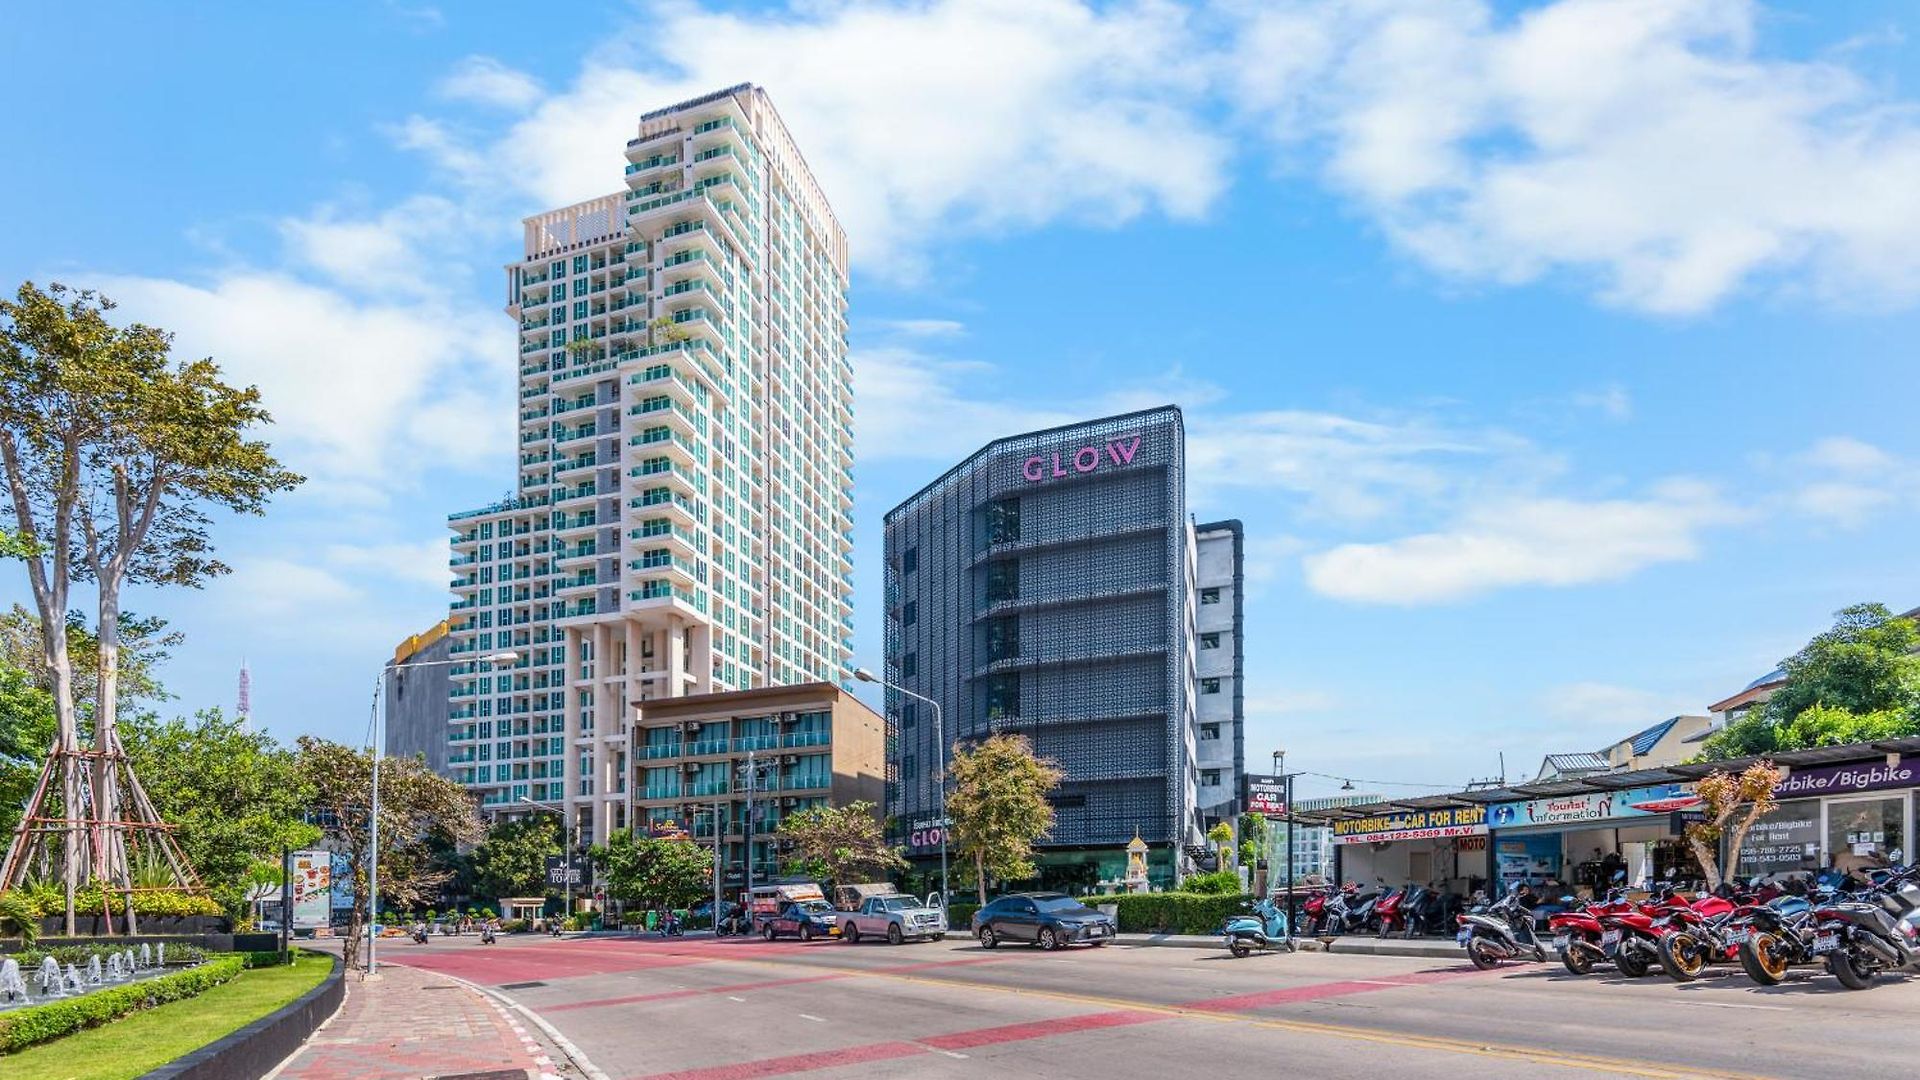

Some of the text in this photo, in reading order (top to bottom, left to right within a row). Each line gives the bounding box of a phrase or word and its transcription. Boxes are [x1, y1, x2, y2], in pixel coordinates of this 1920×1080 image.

[1023, 436, 1141, 481] GLOW
[1772, 768, 1912, 792] orbike/Bigbike
[1257, 793, 1277, 802] CAR
[1547, 801, 1586, 812] Tourist
[1335, 817, 1391, 835] MOTORBIKE
[1404, 812, 1426, 830] CAR
[1429, 810, 1451, 826] FOR
[1455, 805, 1486, 823] RENT
[1459, 837, 1486, 850] MOTO
